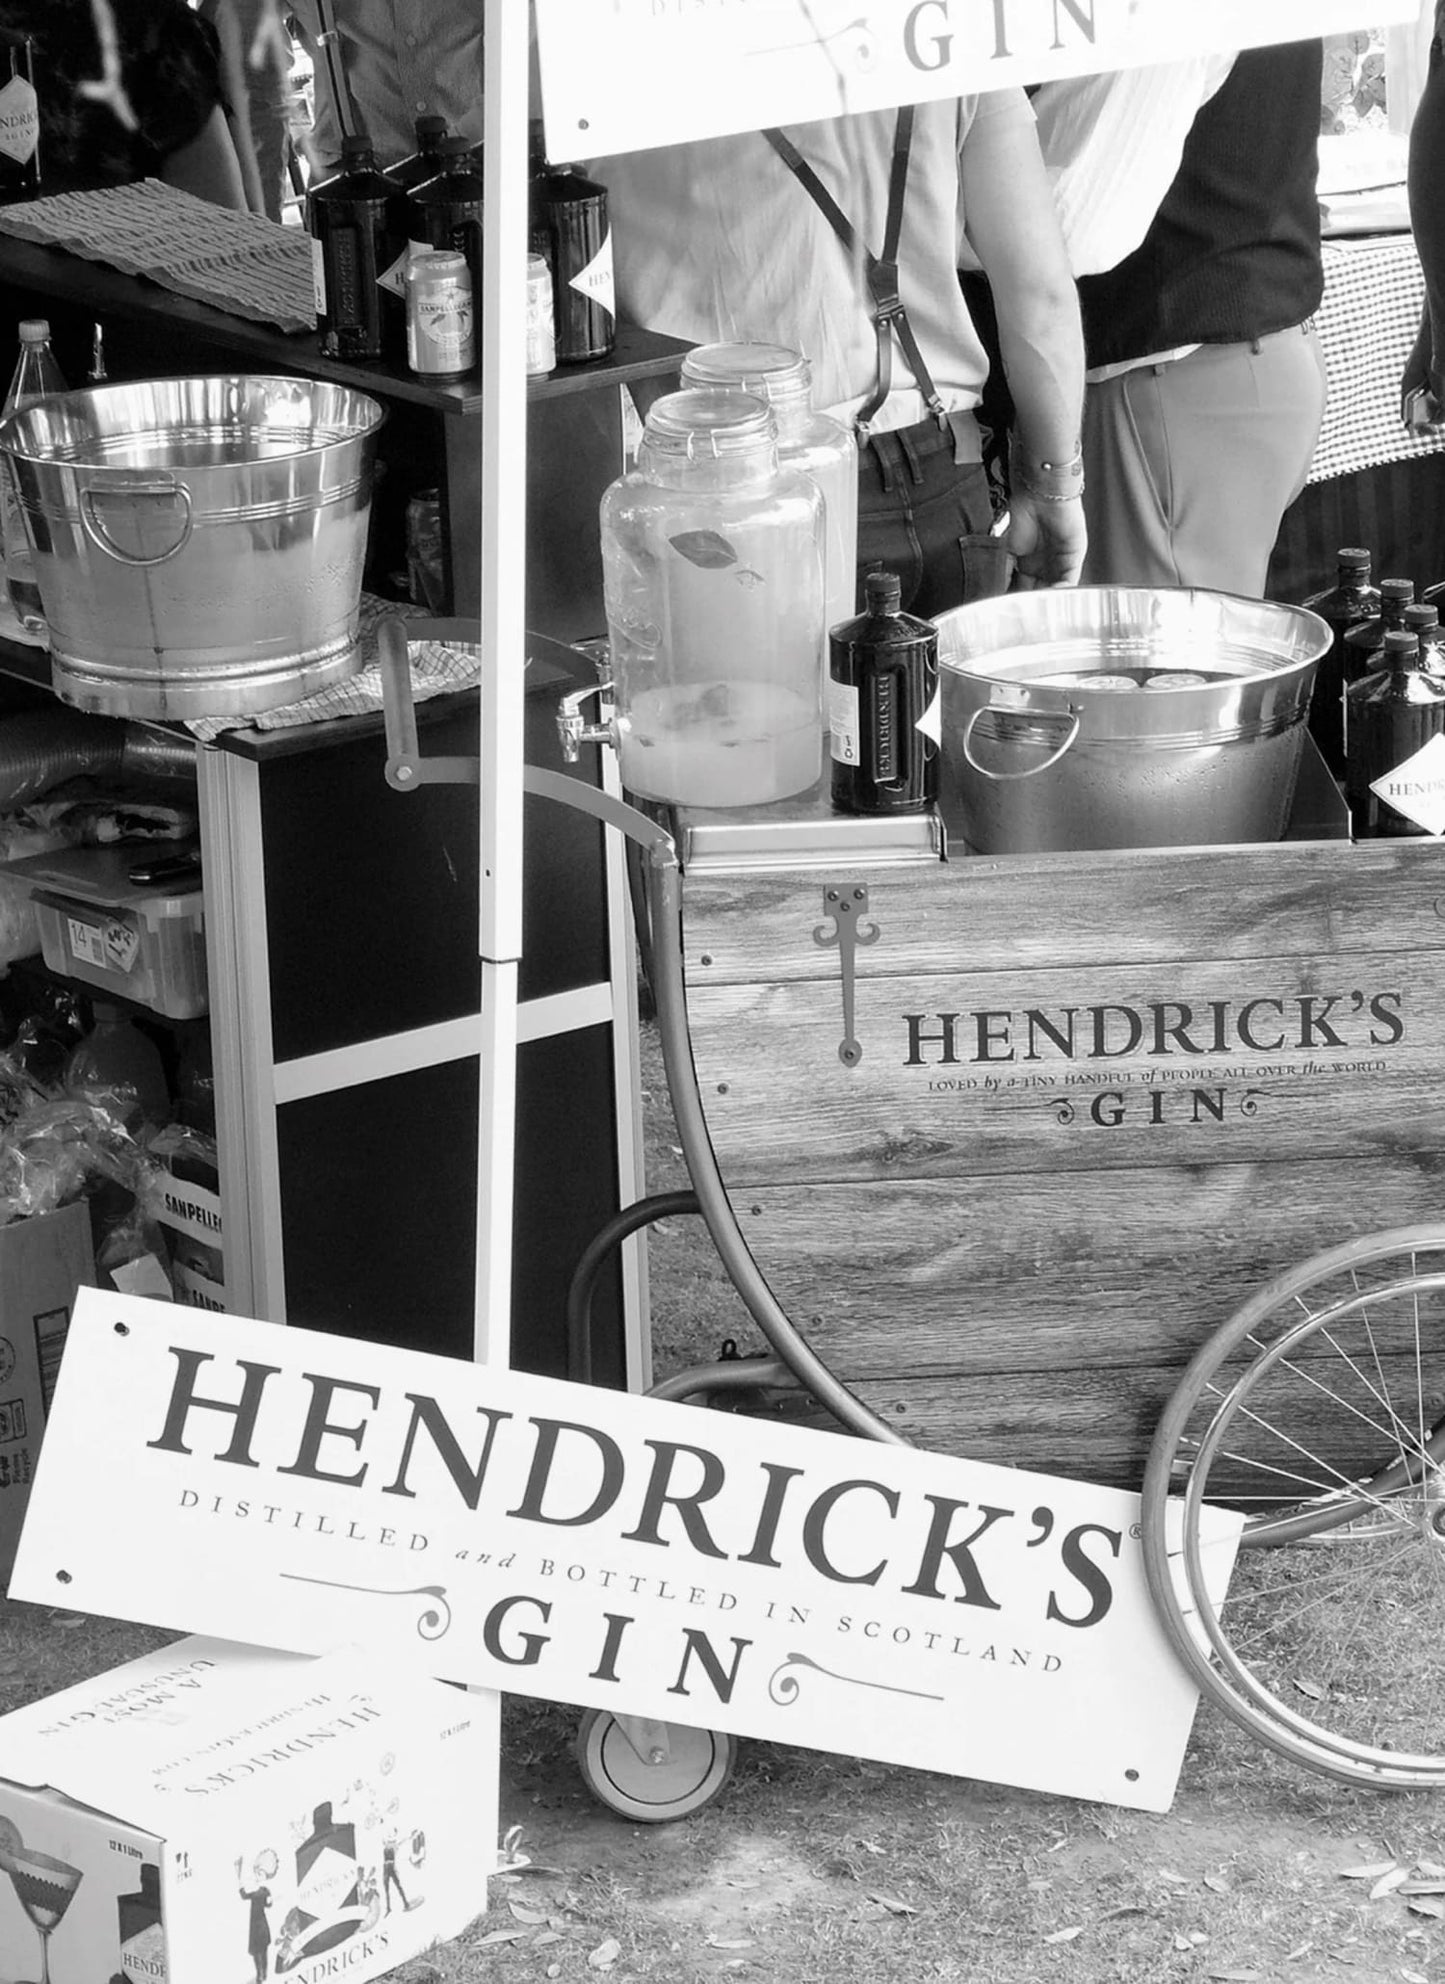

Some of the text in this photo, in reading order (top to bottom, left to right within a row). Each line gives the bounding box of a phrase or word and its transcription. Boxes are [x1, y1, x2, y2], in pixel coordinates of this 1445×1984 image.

[903, 0, 1096, 72] GIN
[902, 990, 1404, 1066] HENDRICK'S
[928, 1078, 977, 1091] LOVED
[984, 1075, 1001, 1091] by
[1023, 1074, 1056, 1087] TINY
[1064, 1071, 1134, 1085] HANDFUL
[1141, 1067, 1157, 1083] of
[1162, 1068, 1218, 1081] PEOPLE
[1223, 1066, 1248, 1079] ALL
[1256, 1064, 1296, 1078] OVER
[1302, 1060, 1325, 1075] the
[1331, 1060, 1387, 1073] WORLD
[1090, 1087, 1227, 1127] GIN
[146, 1345, 1123, 1628] HENDRICK'S
[178, 1489, 1063, 1673] DISTILLED and BOTTLED IN SCOTLAND
[94, 1659, 215, 1709] UNUSUAL
[483, 1594, 754, 1705] GIN
[103, 1691, 175, 1723] MOST
